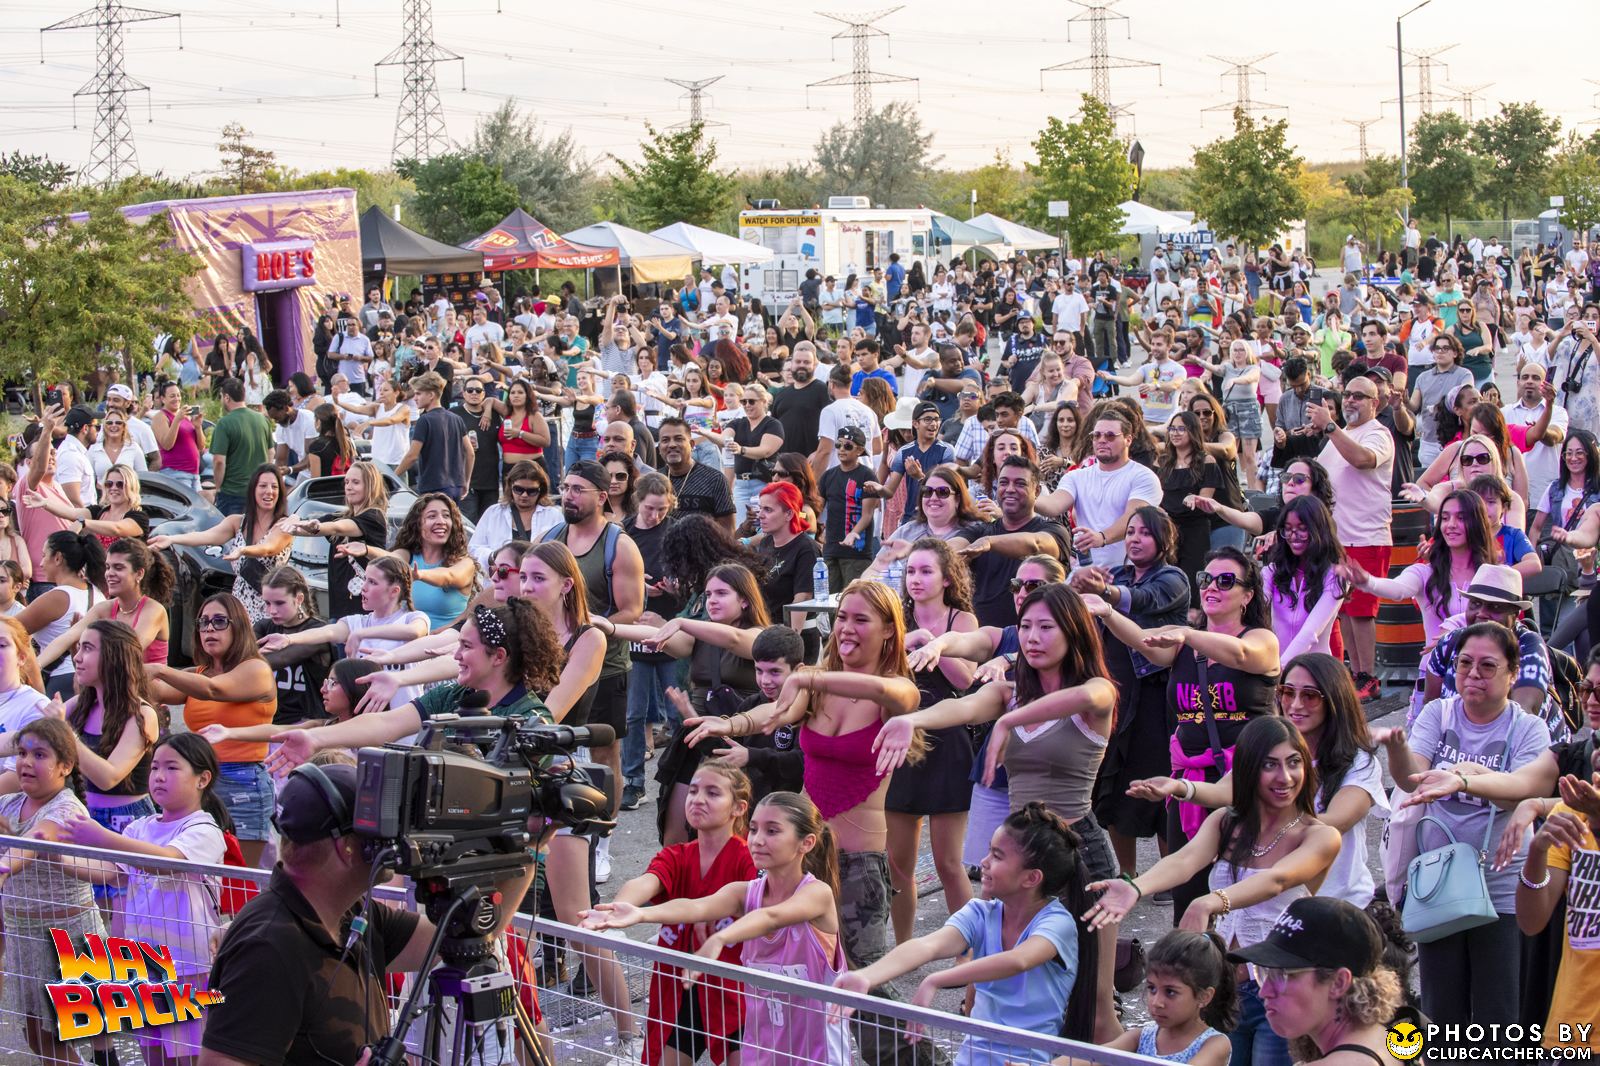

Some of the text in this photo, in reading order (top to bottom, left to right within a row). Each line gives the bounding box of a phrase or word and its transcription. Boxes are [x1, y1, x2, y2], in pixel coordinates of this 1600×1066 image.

[745, 216, 819, 225] WATCH FOR CHILDREN
